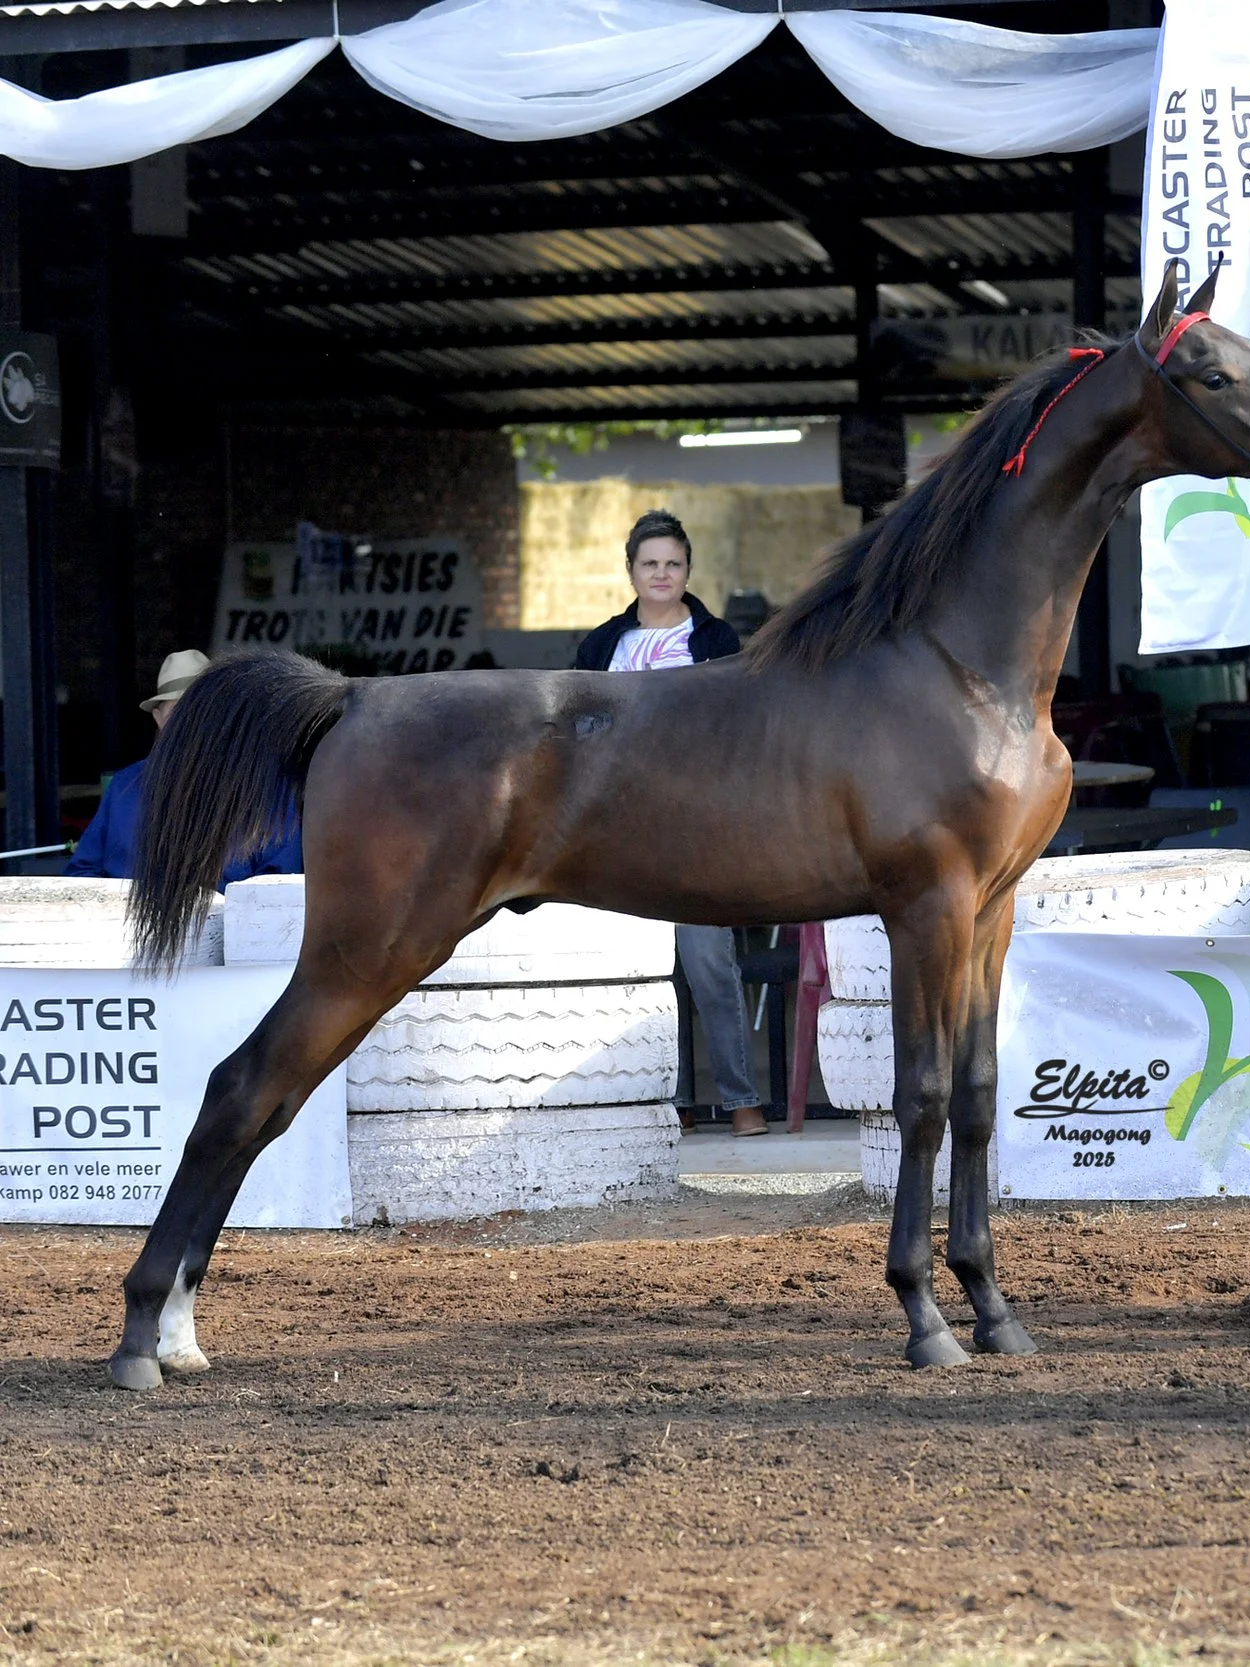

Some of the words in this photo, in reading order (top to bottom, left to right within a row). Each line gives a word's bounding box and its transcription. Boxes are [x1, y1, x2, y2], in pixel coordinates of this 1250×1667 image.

[1201, 88, 1232, 276] TRADING
[340, 605, 409, 642] VAN
[413, 604, 472, 640] DIE
[0, 998, 157, 1031] ASTER
[0, 1051, 158, 1085] ADING
[33, 1105, 161, 1139] POST
[1043, 1124, 1152, 1145] Magogong
[48, 1164, 69, 1176] en
[74, 1161, 111, 1176] vele
[117, 1164, 162, 1176] meer
[1072, 1152, 1115, 1167] 2025
[50, 1185, 79, 1200] 082
[85, 1185, 116, 1200] 948
[122, 1185, 163, 1200] 2077
